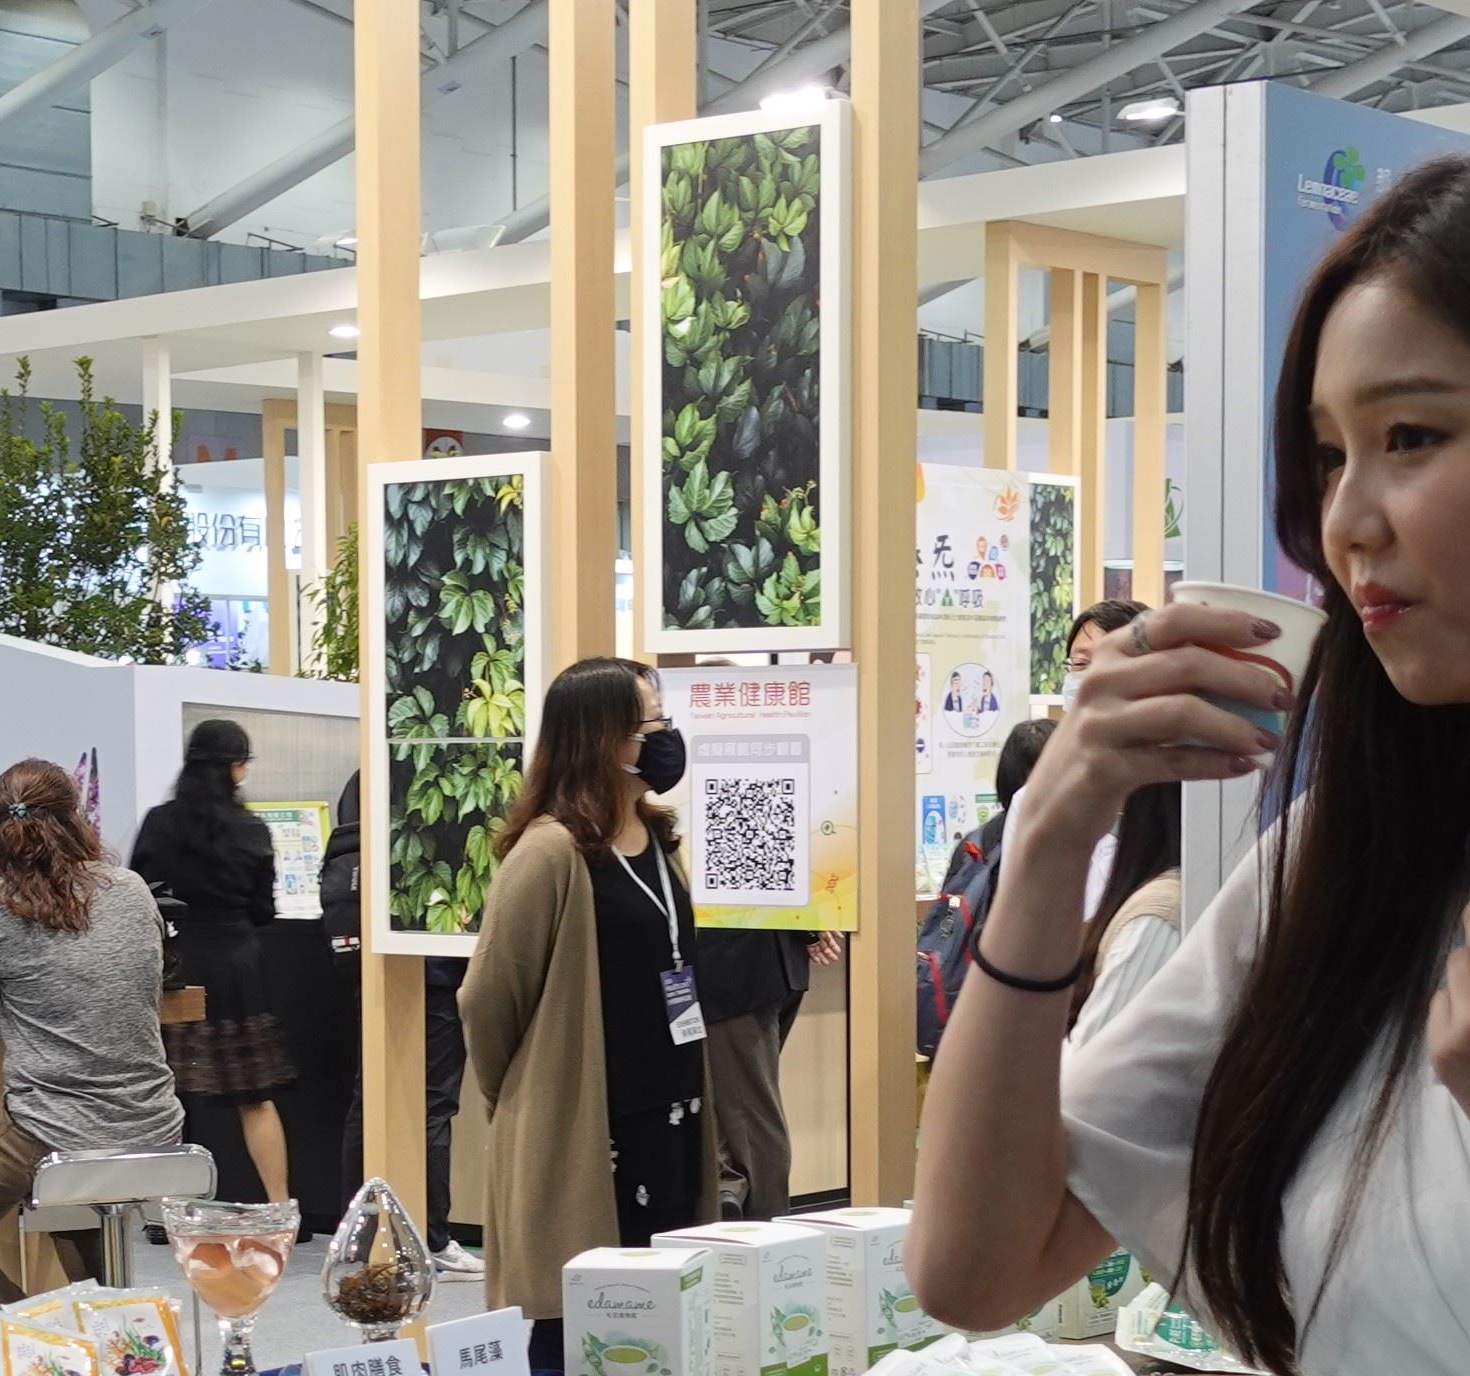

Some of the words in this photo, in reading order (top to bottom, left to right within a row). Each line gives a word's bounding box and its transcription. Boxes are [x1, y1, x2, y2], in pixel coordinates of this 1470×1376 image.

[690, 681, 811, 708] 農業健康館
[587, 1292, 656, 1310] edamame
[459, 1340, 503, 1370] 馬尾藻
